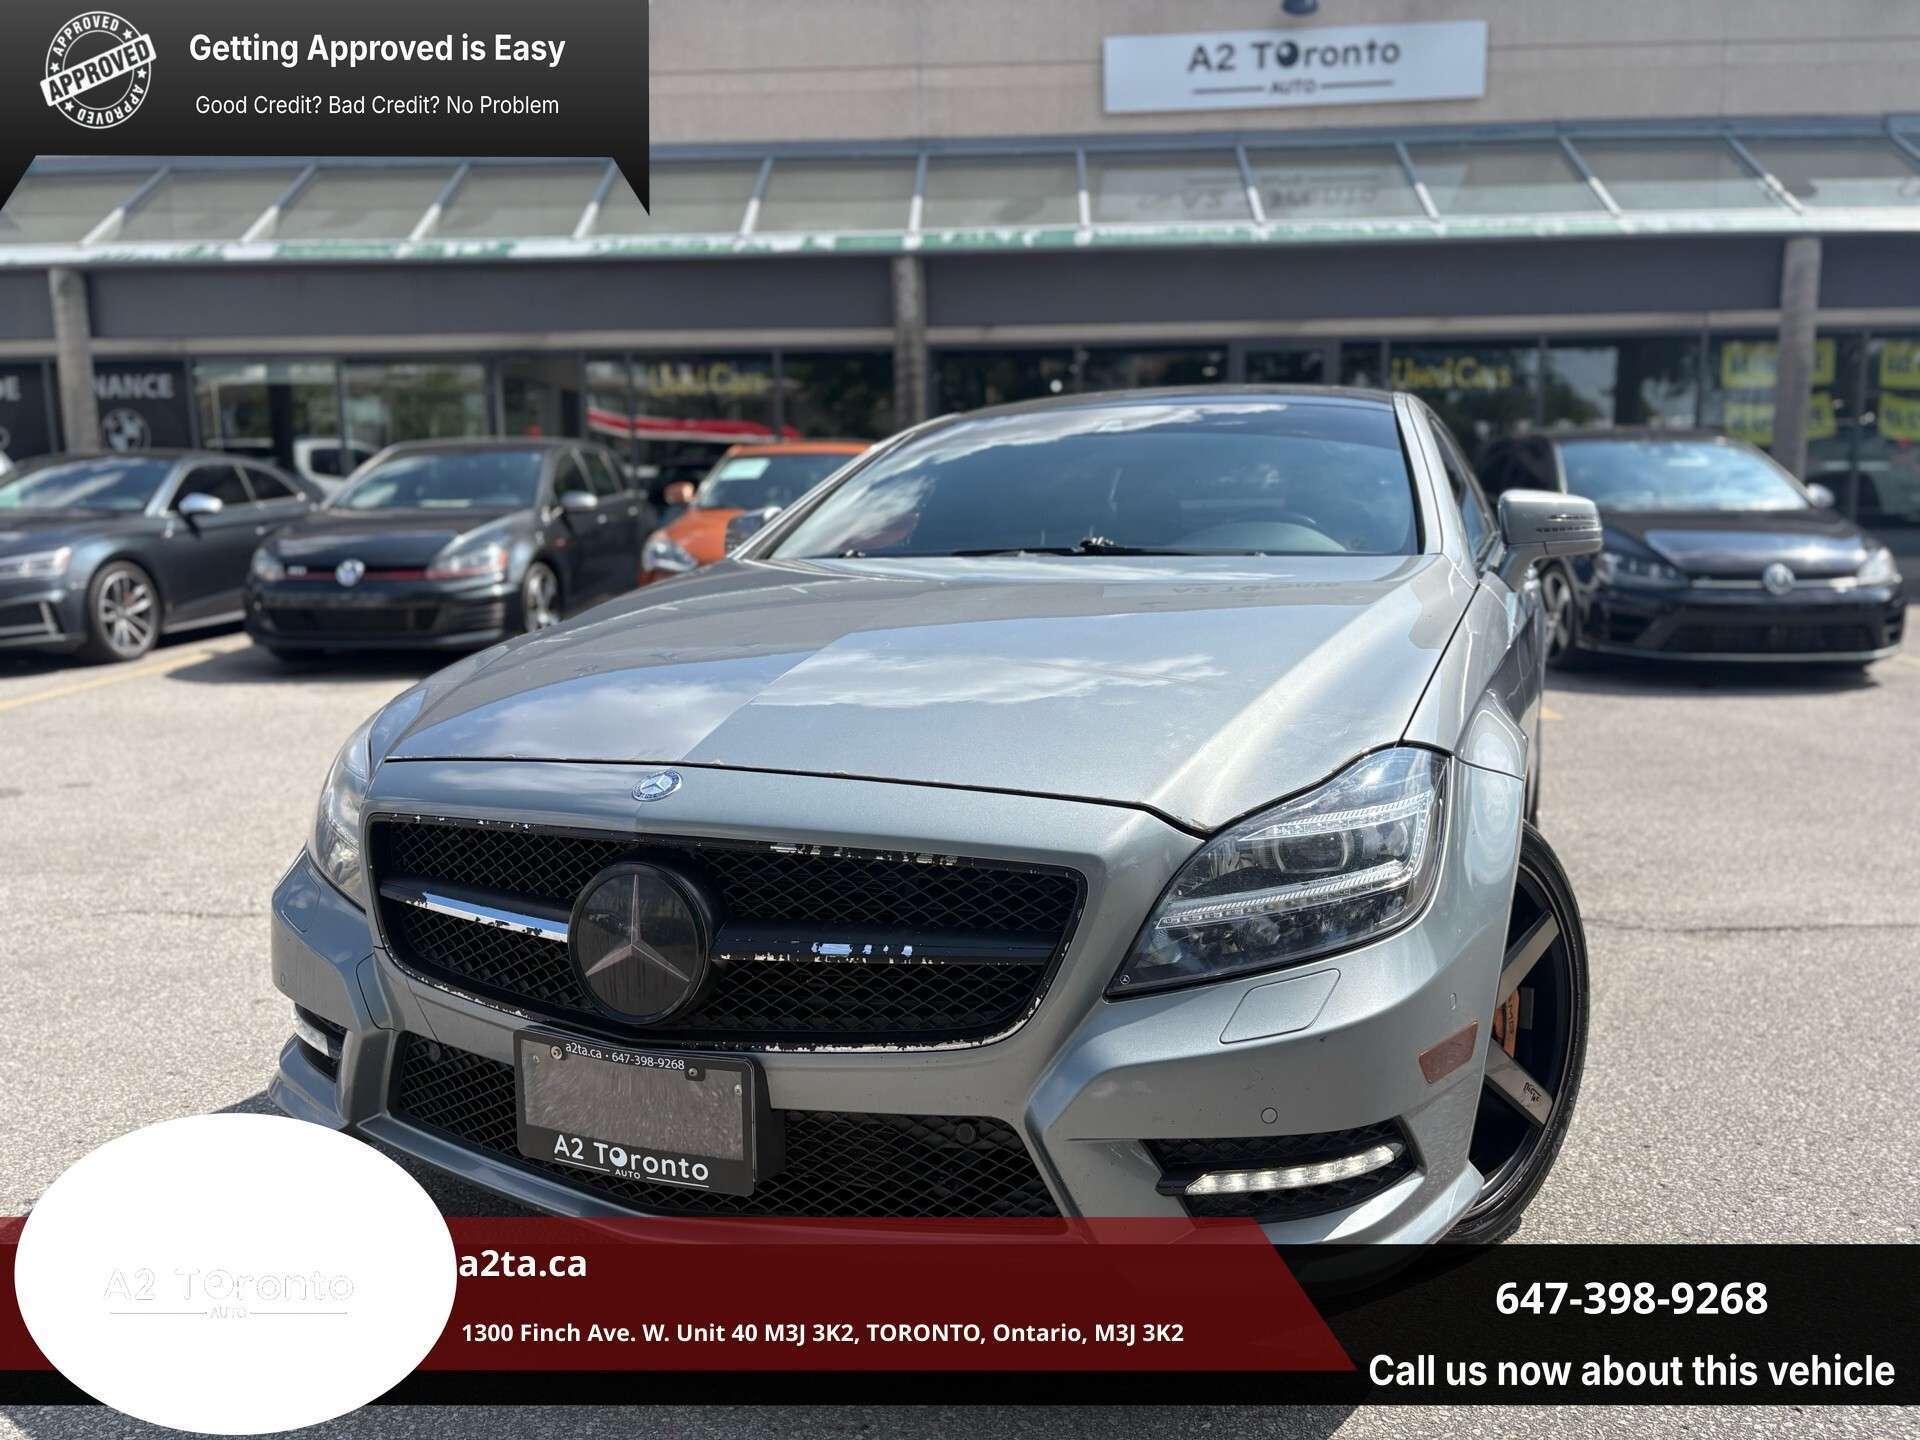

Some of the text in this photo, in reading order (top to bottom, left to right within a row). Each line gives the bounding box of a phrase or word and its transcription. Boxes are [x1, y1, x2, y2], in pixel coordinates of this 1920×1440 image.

[1187, 42, 1236, 73] A2
[1270, 78, 1317, 95] AUTO
[565, 1042, 685, 1071] a2ta.ca 647-398-9268
[553, 1134, 585, 1161] A2
[614, 1168, 641, 1180] AUTO
